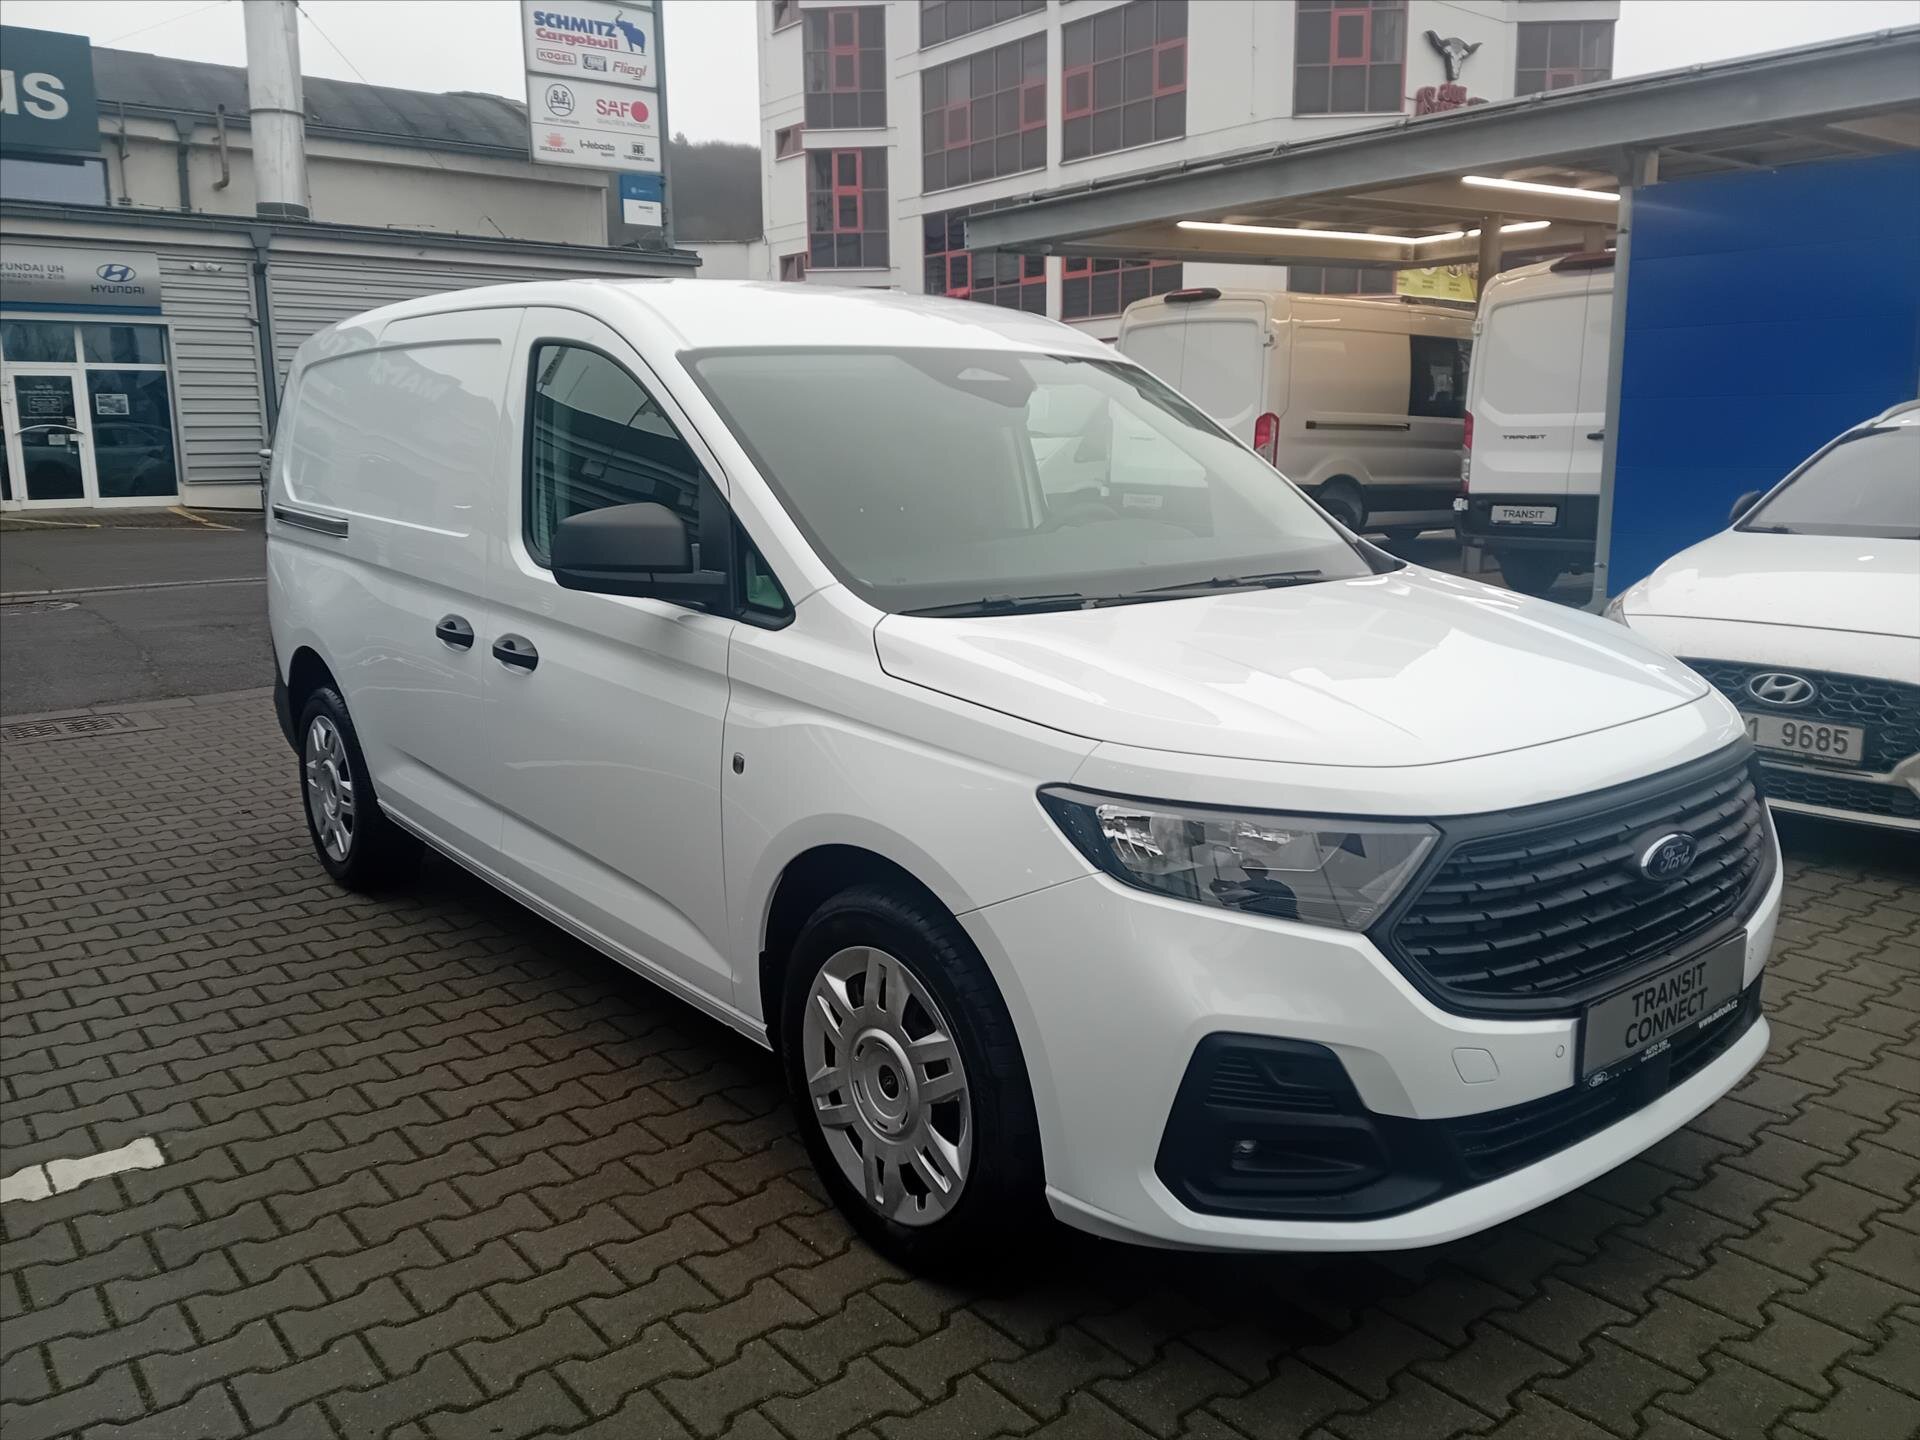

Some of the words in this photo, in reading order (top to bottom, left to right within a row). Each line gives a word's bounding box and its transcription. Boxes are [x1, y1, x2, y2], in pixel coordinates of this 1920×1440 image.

[534, 10, 617, 38] SCHMITZ
[536, 27, 619, 50] Cargobull
[596, 99, 630, 118] SAF
[579, 139, 615, 151] Webasto
[90, 284, 145, 295] HYUNDAI
[1502, 509, 1545, 519] TRANSIT
[1781, 721, 1850, 755] 9685
[1660, 842, 1691, 873] Ford
[1632, 961, 1707, 1018] TRANSIT
[1625, 987, 1709, 1049] CONNECT
